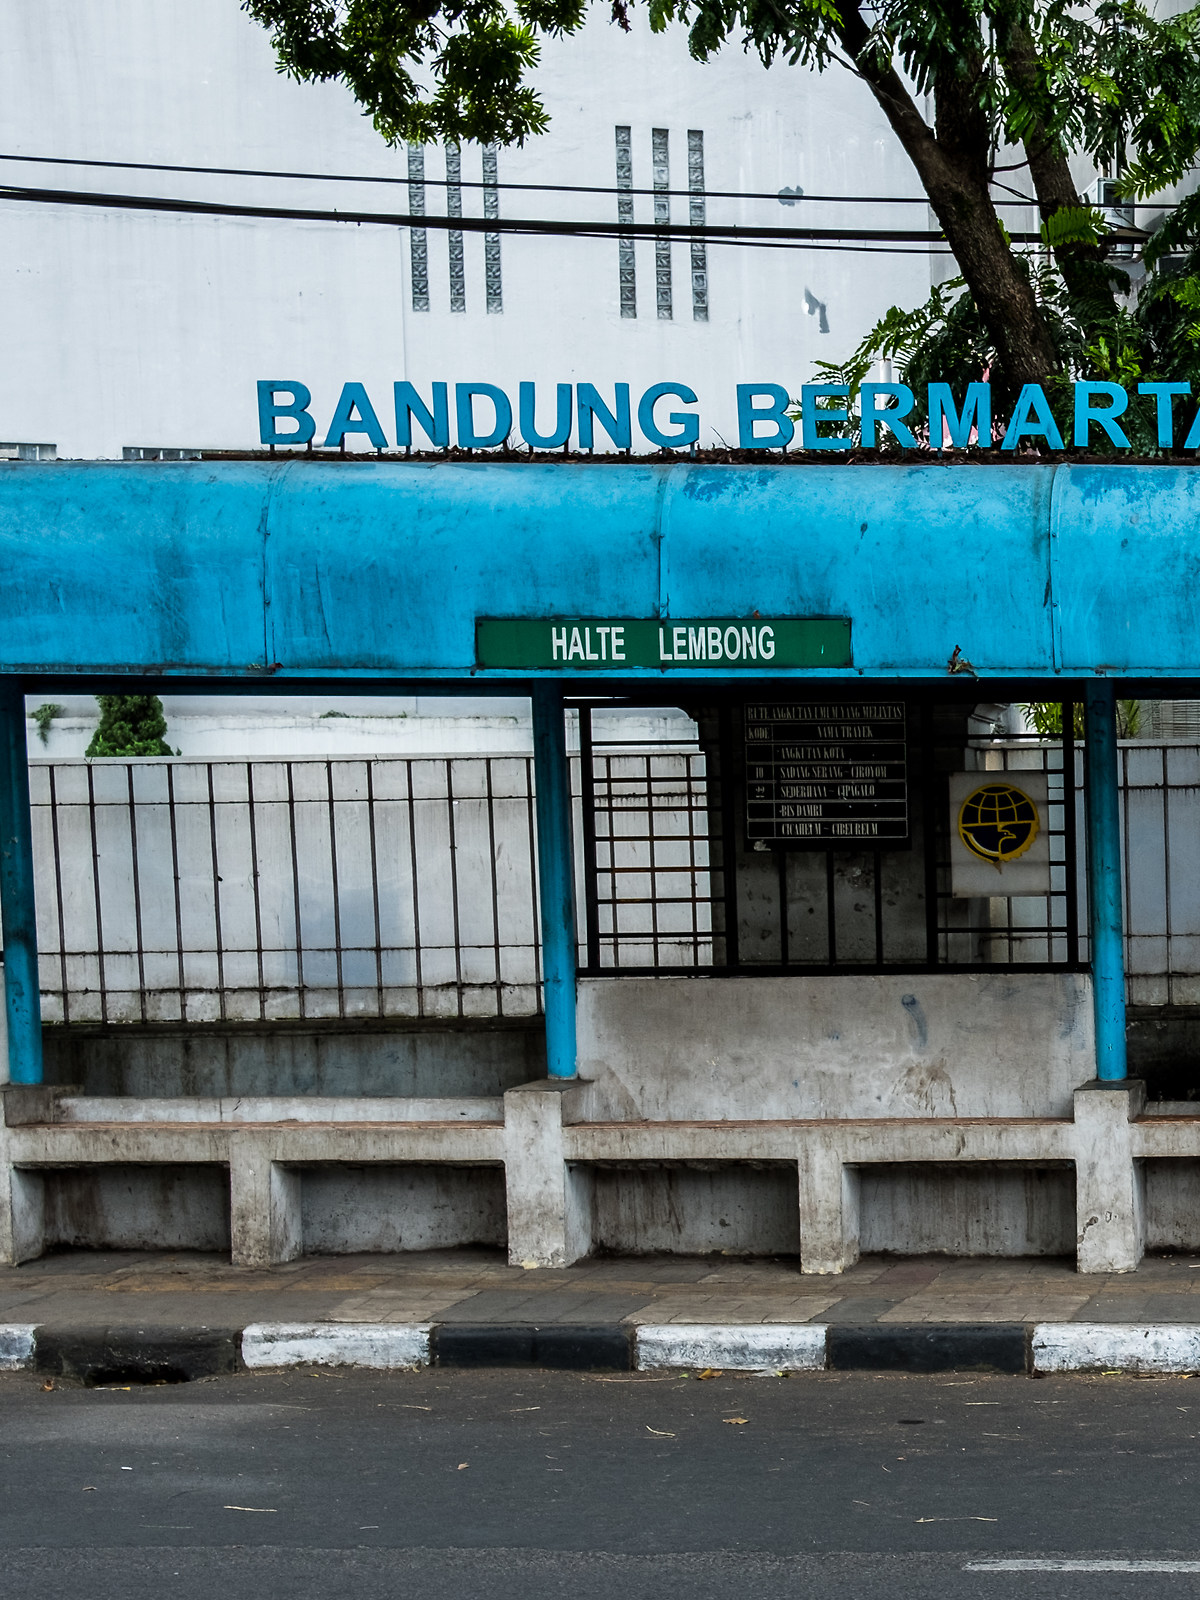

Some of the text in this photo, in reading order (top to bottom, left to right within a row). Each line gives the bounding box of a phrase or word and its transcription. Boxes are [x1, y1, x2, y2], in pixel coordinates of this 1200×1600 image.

[256, 379, 701, 450] BANDUNG
[551, 625, 776, 662] HALTE LEMBONG
[773, 706, 813, 720] ANGKUTAN
[840, 706, 860, 719] YANG
[863, 705, 902, 719] MELINTAS
[748, 727, 770, 740] KODE
[817, 725, 874, 739] NAMA TRAYEK
[781, 747, 845, 760] ANGKUTAN KOTA
[755, 766, 764, 779] 10
[780, 766, 811, 779] SADANG
[812, 765, 843, 778] SERANG
[851, 765, 887, 778] CIROYOM
[780, 785, 827, 798] SEDERHANA
[837, 784, 875, 797] CIPAGALO
[796, 804, 823, 817] DAMRI
[781, 822, 822, 836] CICAHEUM
[831, 822, 878, 836] CIBEUREUM
